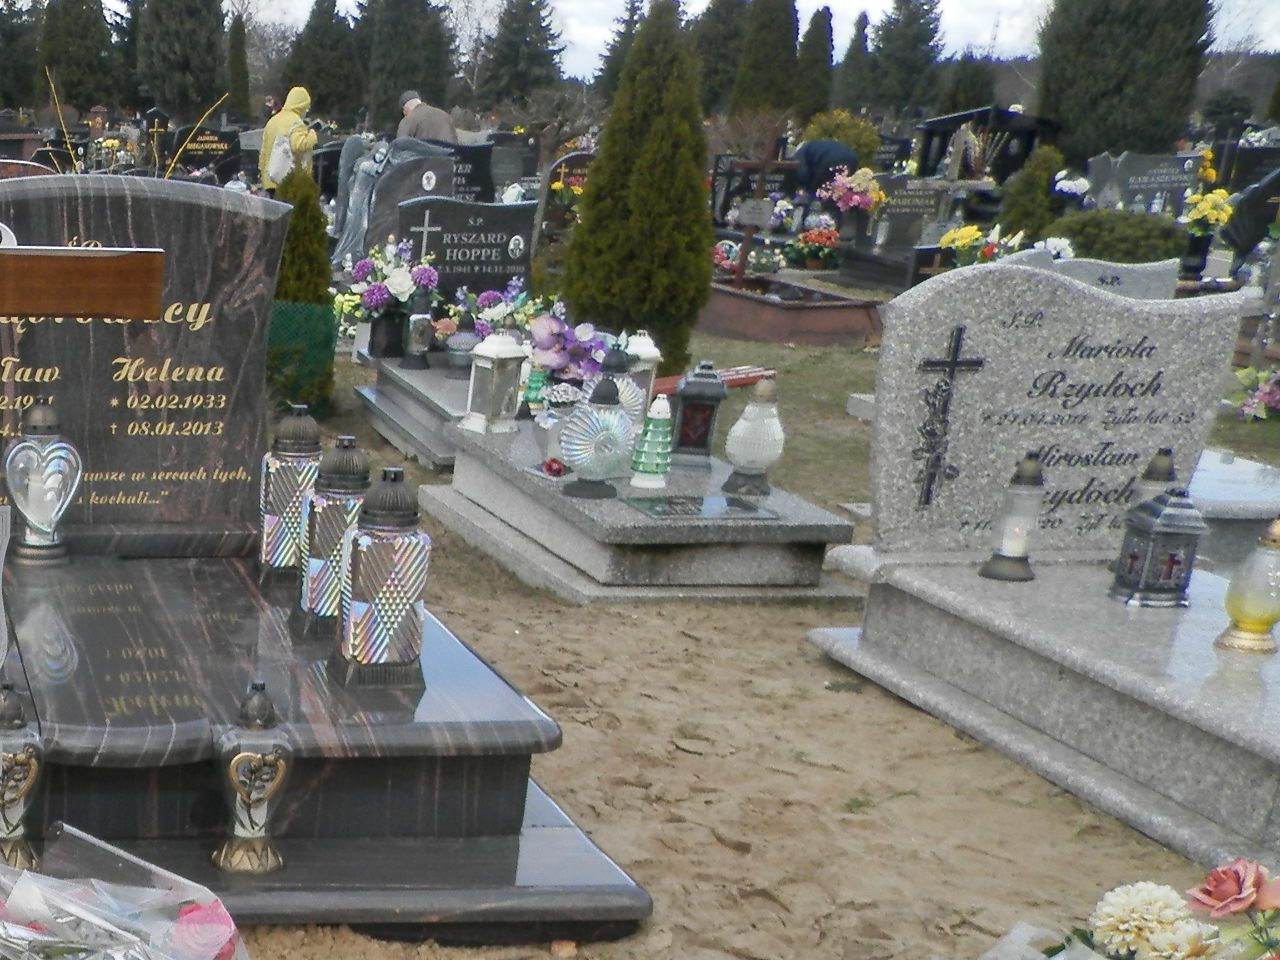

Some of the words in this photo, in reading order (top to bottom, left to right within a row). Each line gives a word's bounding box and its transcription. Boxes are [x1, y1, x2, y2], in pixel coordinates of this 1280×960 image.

[442, 233, 507, 245] RYSZARD
[445, 248, 501, 261] HOPPE
[1047, 335, 1157, 359] Mariola
[111, 357, 225, 382] Helena
[126, 394, 226, 410] 02.02.1933
[127, 422, 224, 437] 08.01.2013
